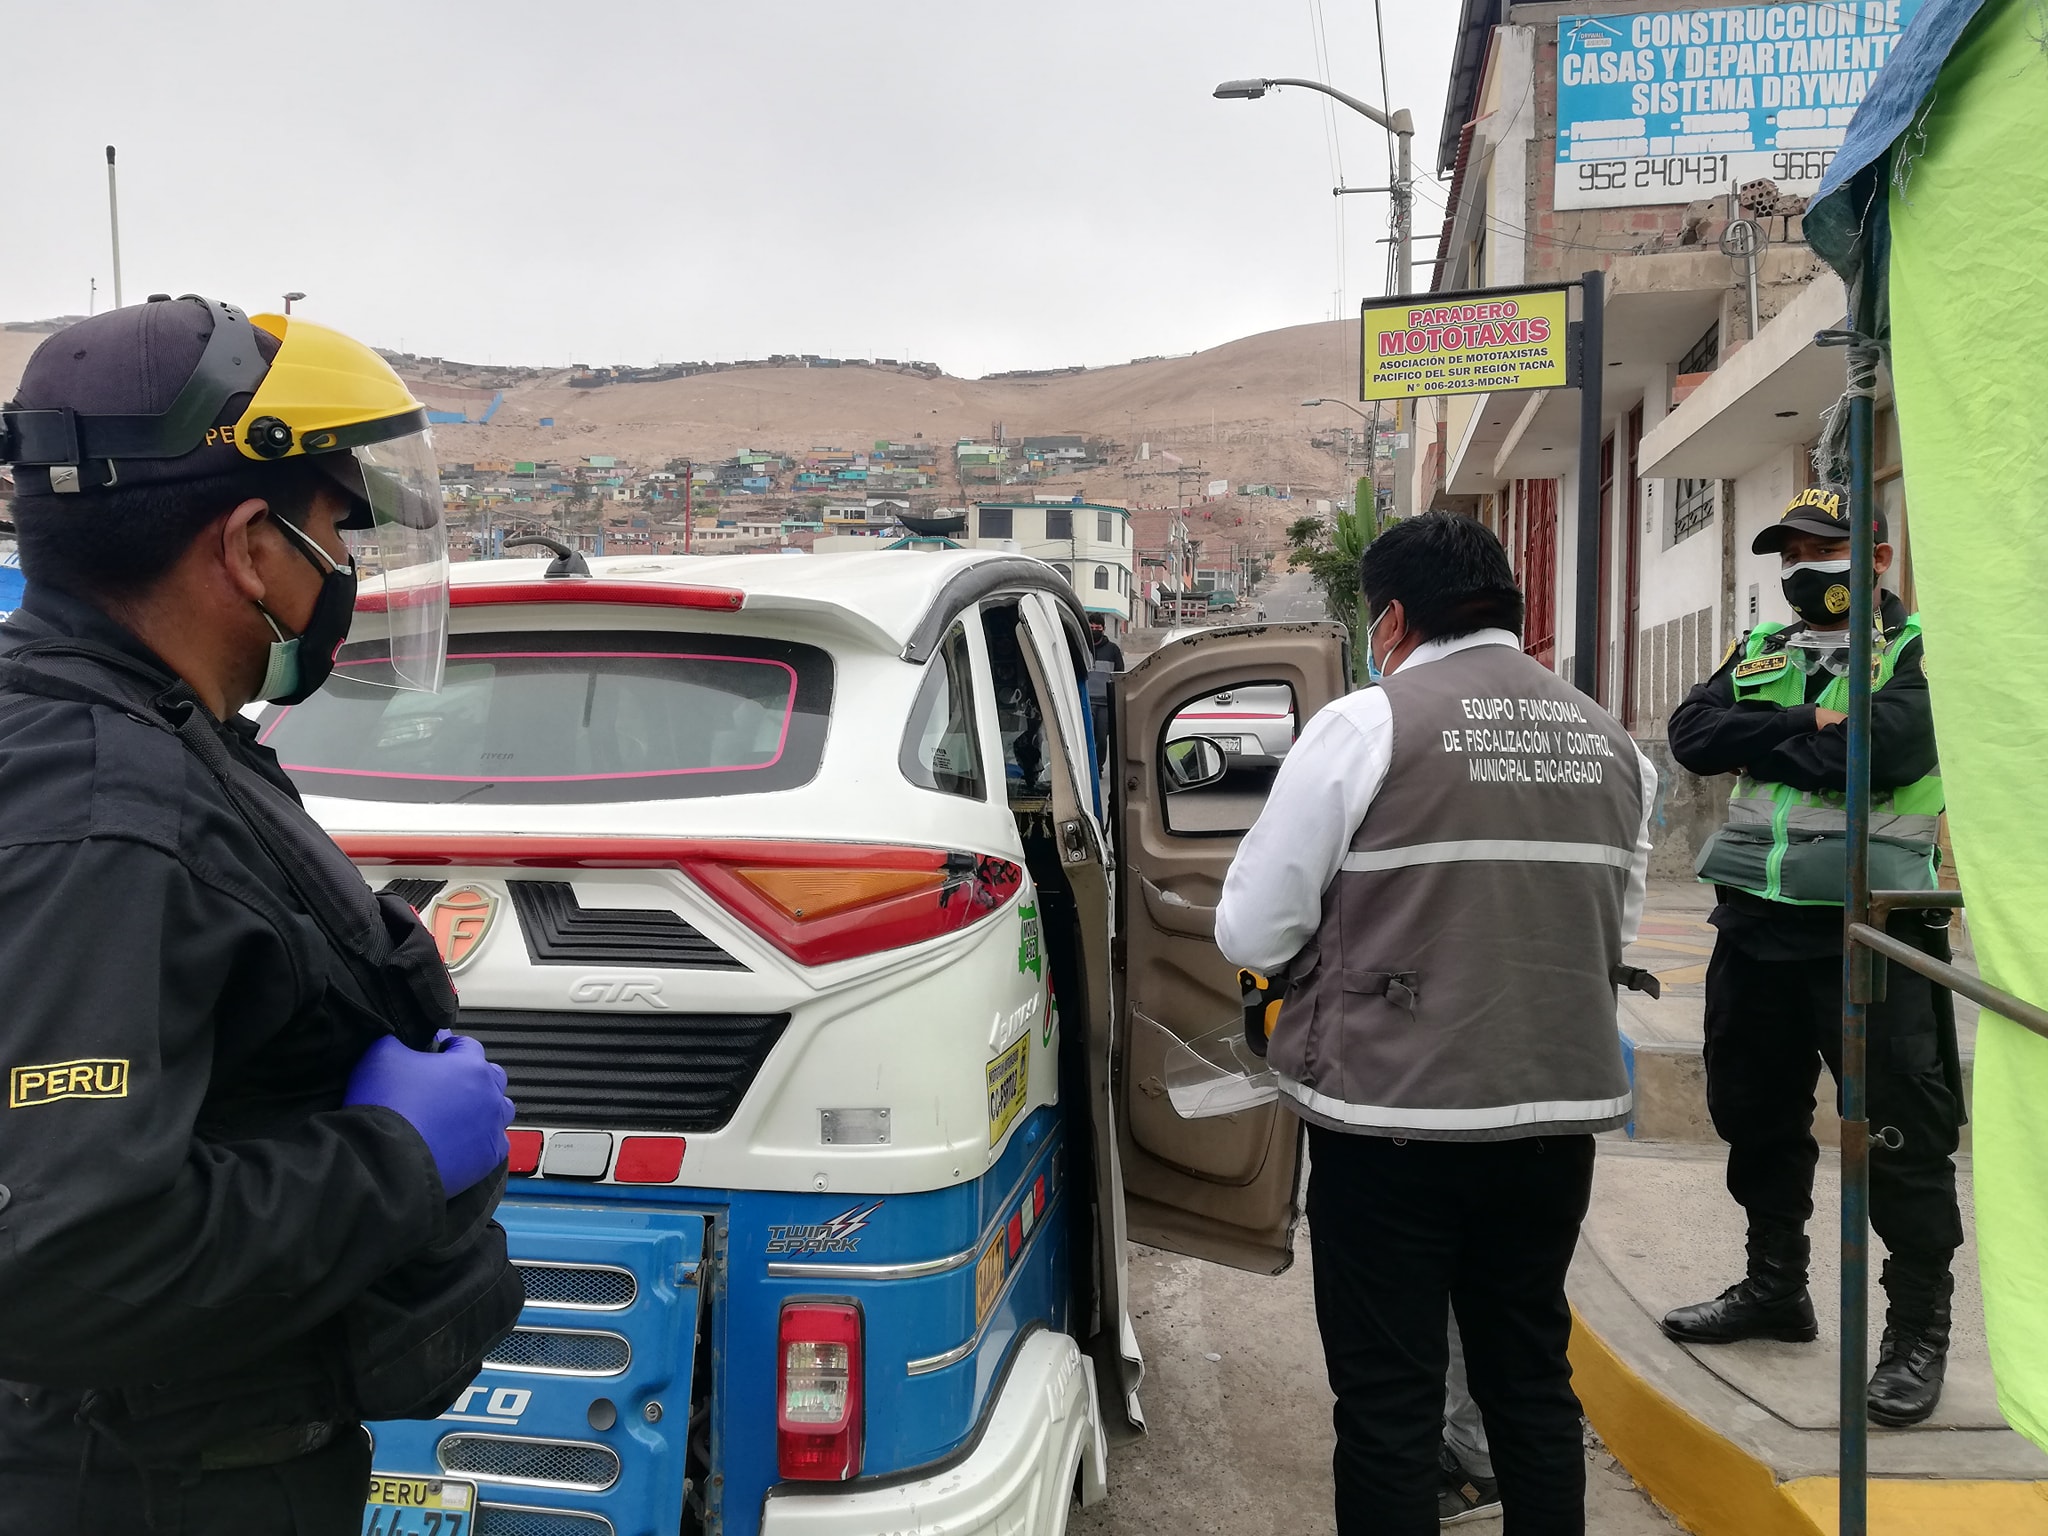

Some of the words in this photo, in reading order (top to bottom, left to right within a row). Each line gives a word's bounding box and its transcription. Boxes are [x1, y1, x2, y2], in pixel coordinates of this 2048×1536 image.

[1632, 1, 1857, 48] CONSTRUCCION
[1864, 1, 1900, 34] DE
[1563, 48, 1654, 86] CASAS
[1662, 47, 1680, 80] Y
[1685, 34, 1903, 79] DEPARTAMENT
[1632, 77, 1755, 115] SISTEMA
[1579, 161, 1626, 190] 952
[1635, 155, 1728, 187] 240431
[1408, 302, 1518, 327] PARADERO
[1379, 318, 1550, 356] MOTOTAXIS
[1373, 371, 1422, 383] PACIFICO
[1425, 369, 1446, 379] DEL
[1448, 367, 1471, 377] SUR
[1474, 361, 1516, 374] REGIÓN
[1519, 360, 1555, 370] TACNA
[1379, 355, 1445, 370] ASOCIACIÓN
[1449, 355, 1463, 364] DE
[1466, 347, 1548, 363] MOTOTAXISTAS
[1424, 375, 1519, 391] 006-2013-MDCN-T
[1461, 698, 1514, 720] EQUIPO
[1518, 698, 1587, 723] FUNCIONAL
[1442, 730, 1462, 752] DE
[1466, 722, 1551, 753] FISCALIZACIÓN
[1554, 732, 1562, 753] Y
[1567, 732, 1614, 757] CONTROL
[1469, 757, 1531, 782] MUNICIPAL
[1534, 760, 1603, 784] ENCARGADO
[570, 975, 669, 1009] GTR
[19, 1066, 119, 1100] PERU
[765, 1238, 861, 1254] SPARK
[767, 1225, 833, 1240] TWIN
[367, 1480, 428, 1505] PERU
